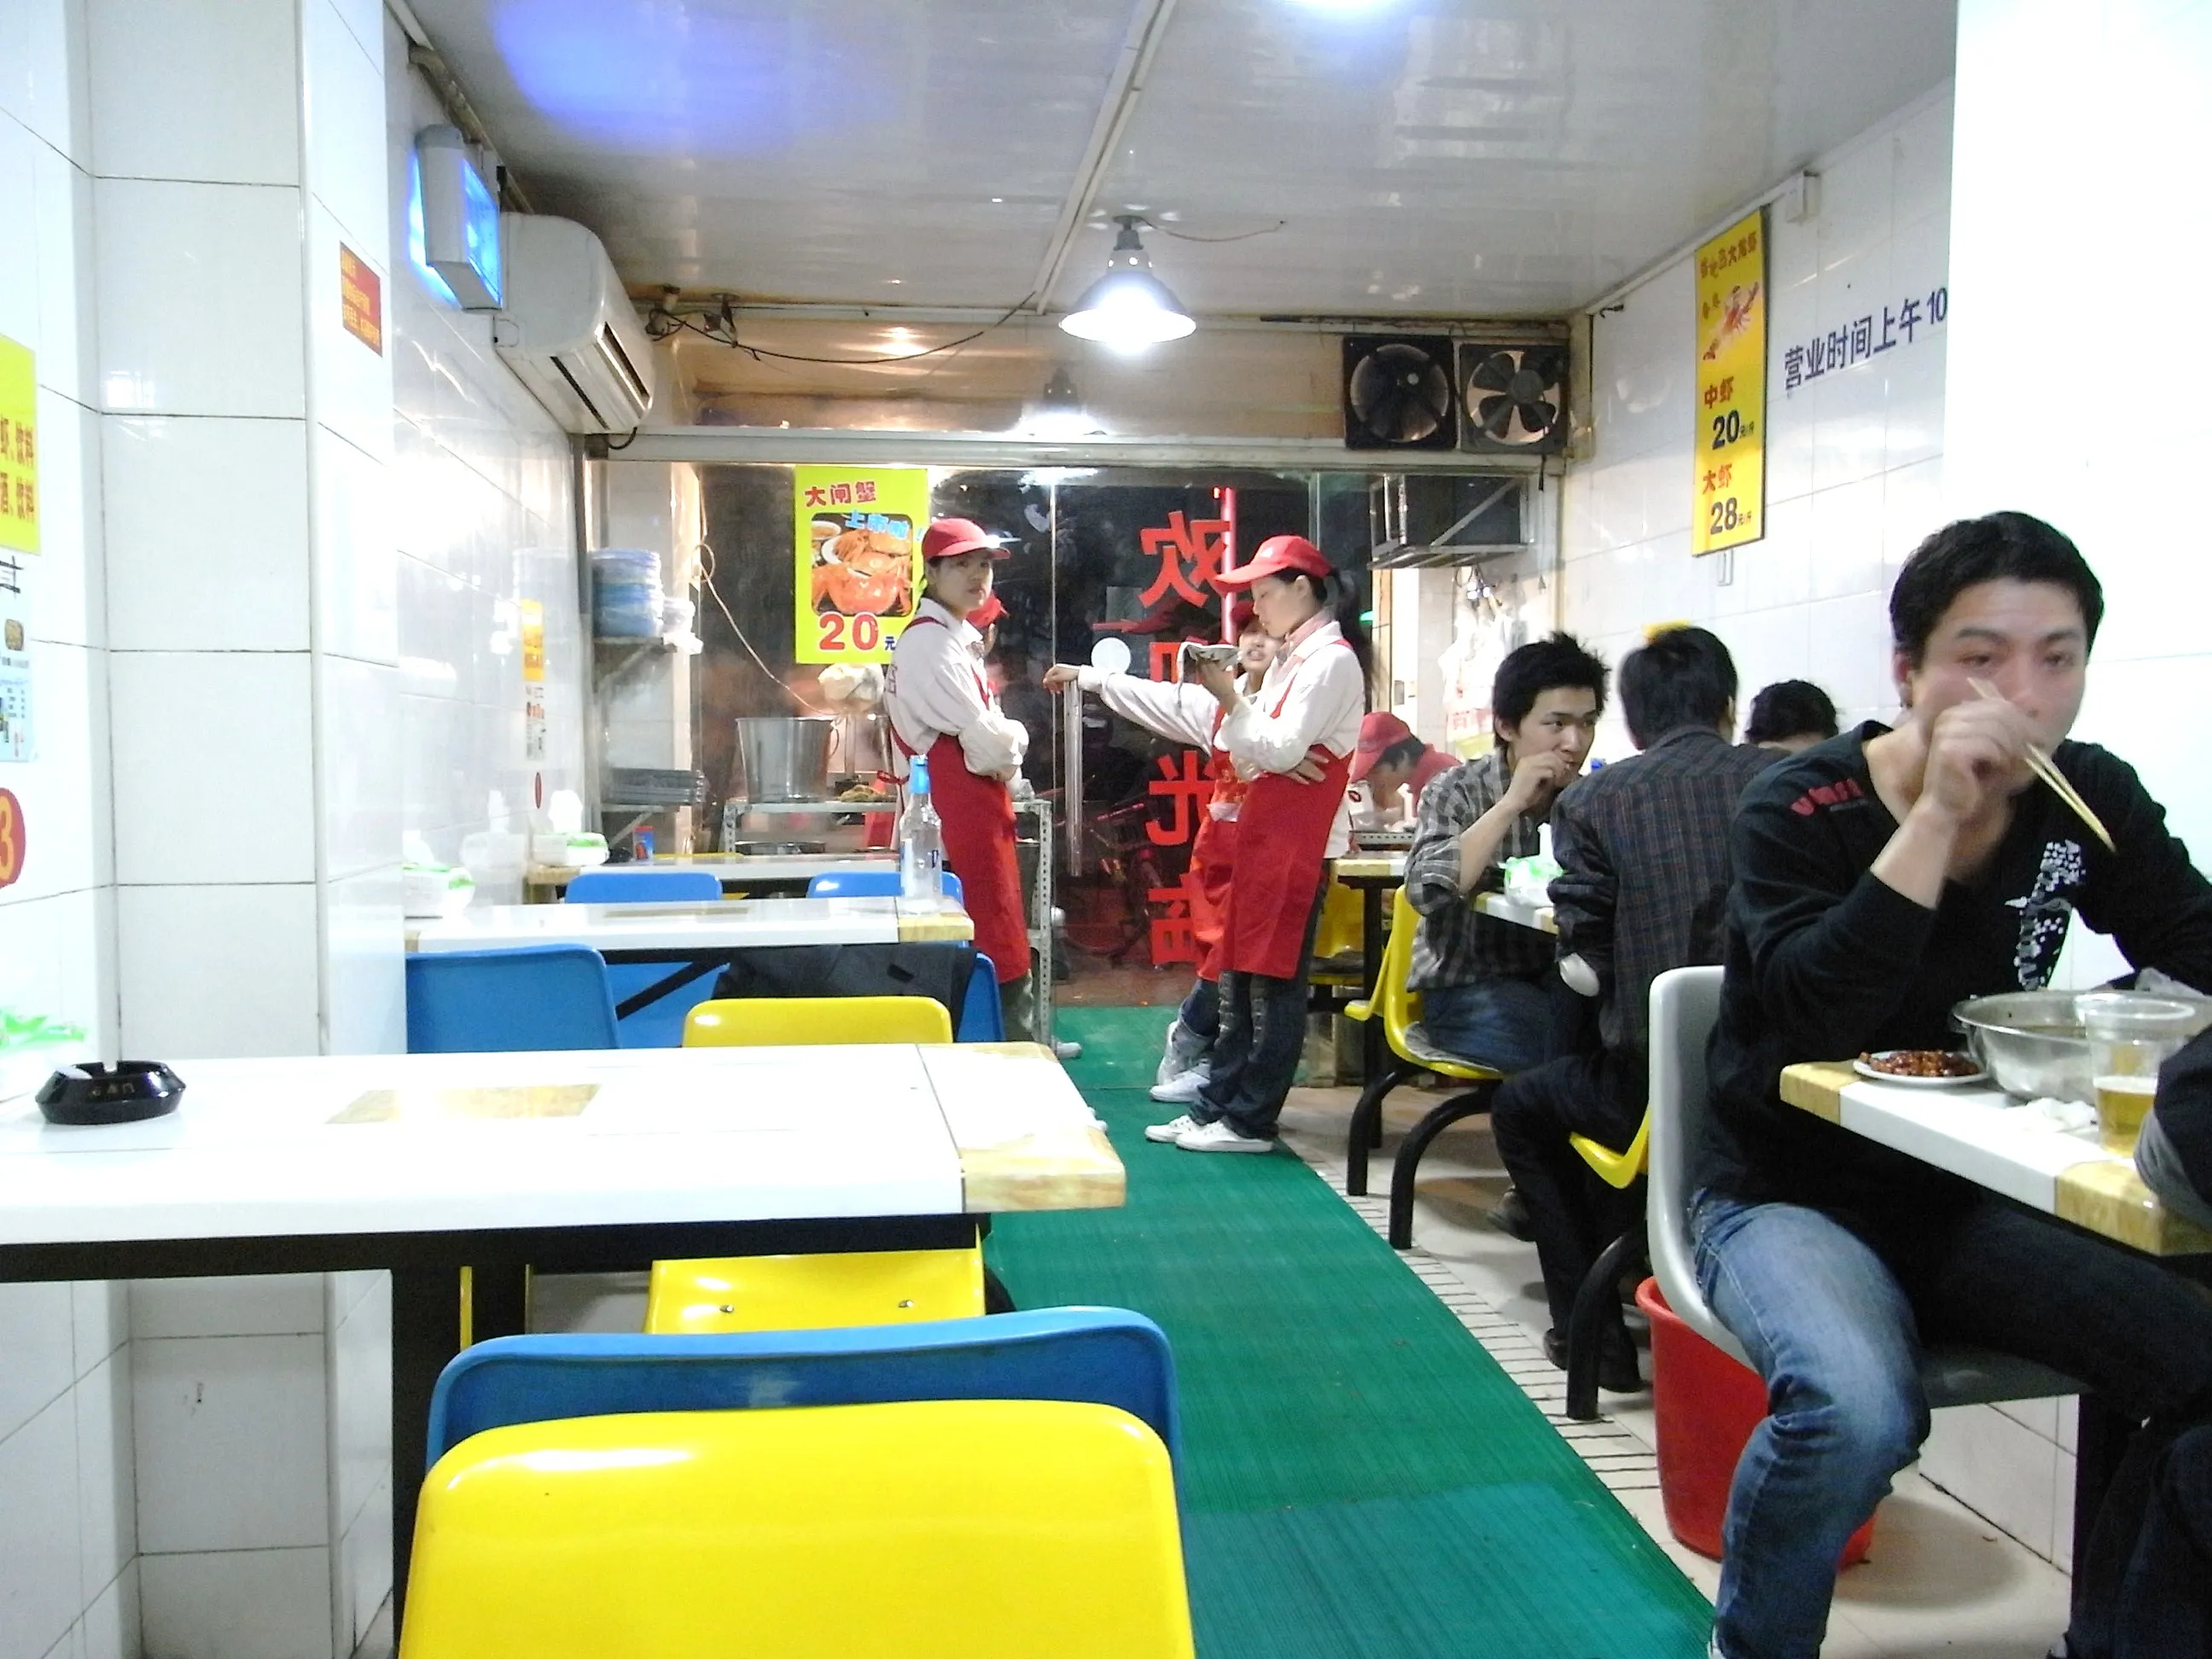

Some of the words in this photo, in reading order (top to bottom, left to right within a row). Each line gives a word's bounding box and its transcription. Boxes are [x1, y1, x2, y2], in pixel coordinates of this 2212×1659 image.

[1784, 287, 1947, 391] 营业时间上午10
[1703, 376, 1734, 409] 中虾
[805, 481, 876, 507] 大闸蟹
[1703, 463, 1732, 494] 大虾
